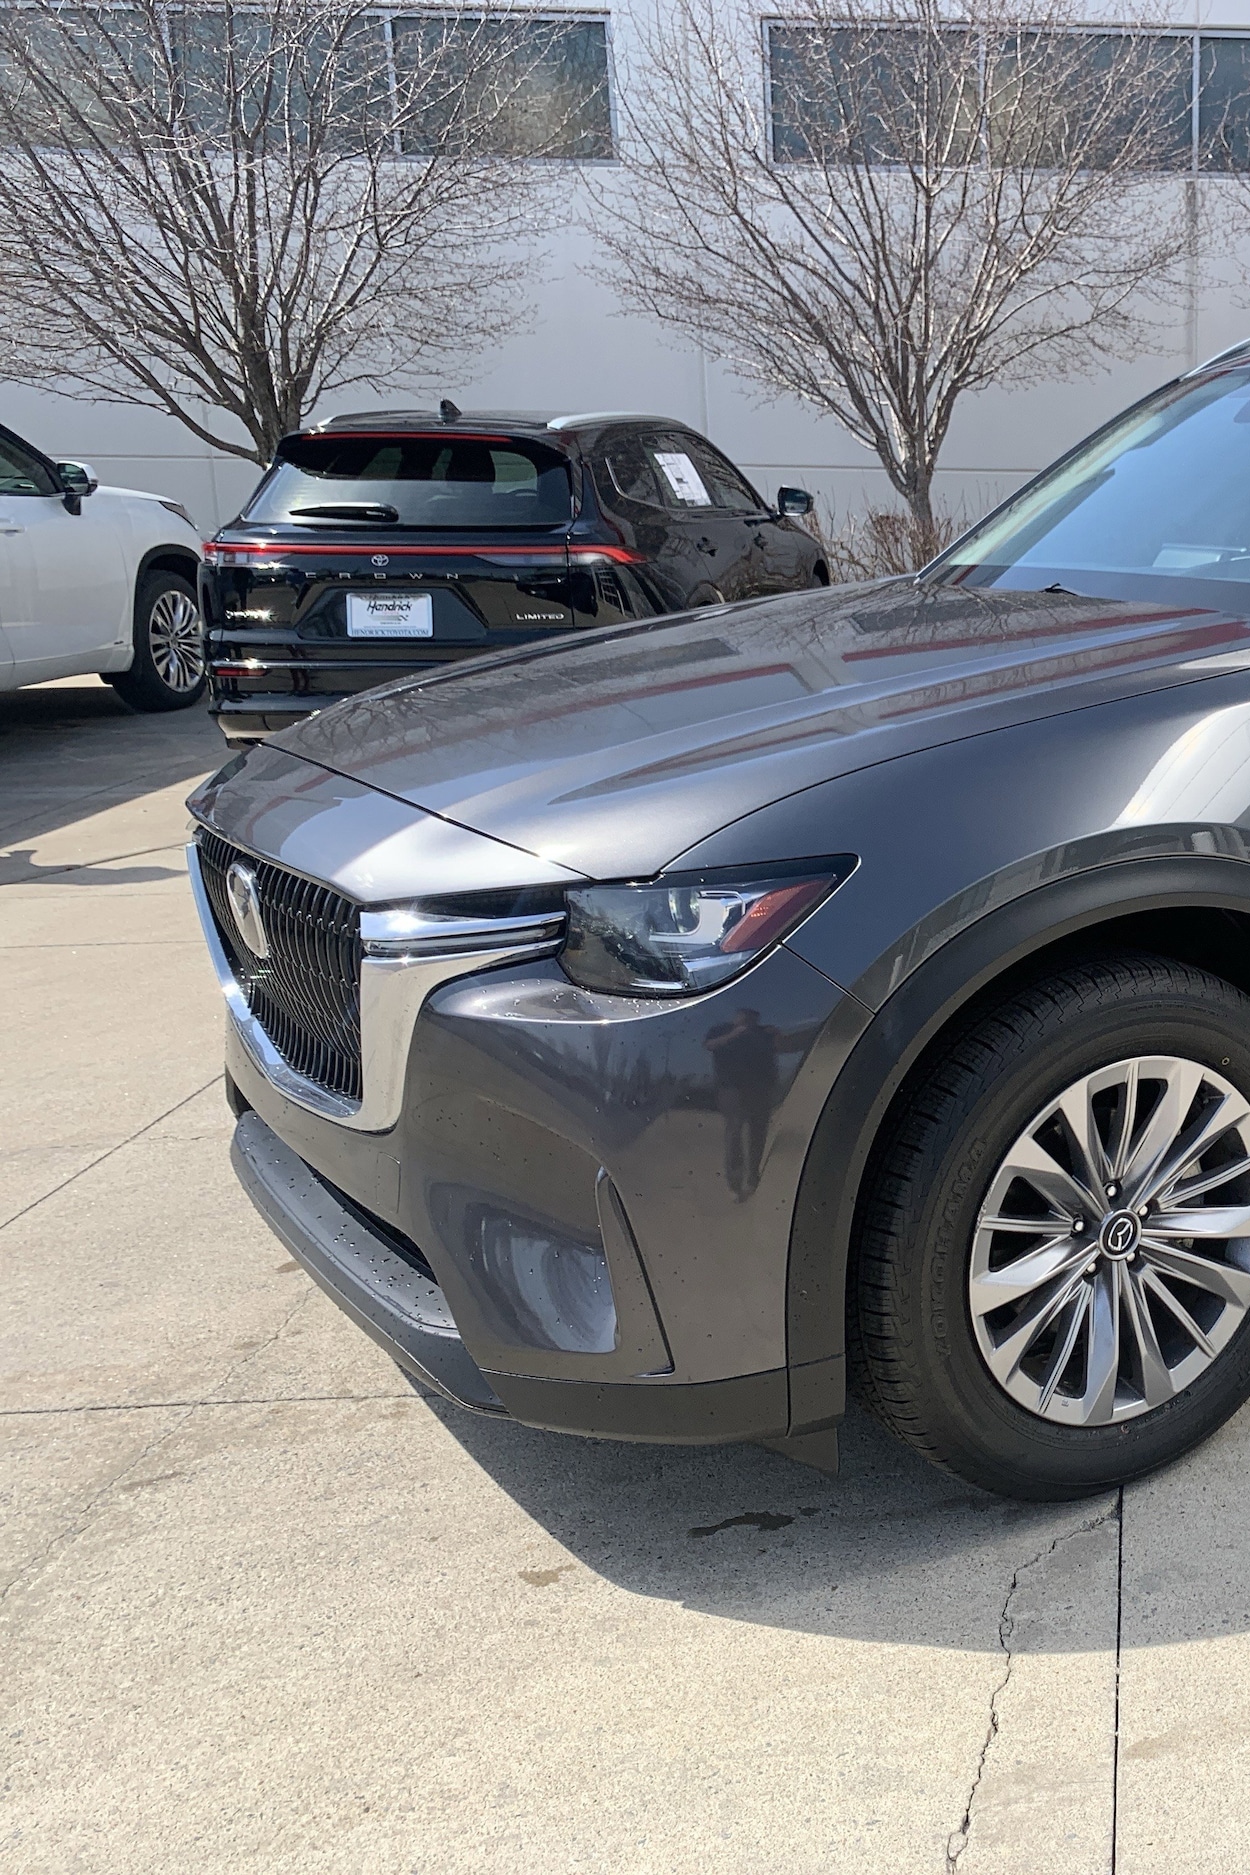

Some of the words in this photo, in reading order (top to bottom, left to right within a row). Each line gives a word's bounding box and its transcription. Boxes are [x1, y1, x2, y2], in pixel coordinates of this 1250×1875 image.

[305, 571, 460, 580] CROWN
[367, 600, 413, 615] Hendrick
[515, 612, 565, 621] LIMITED
